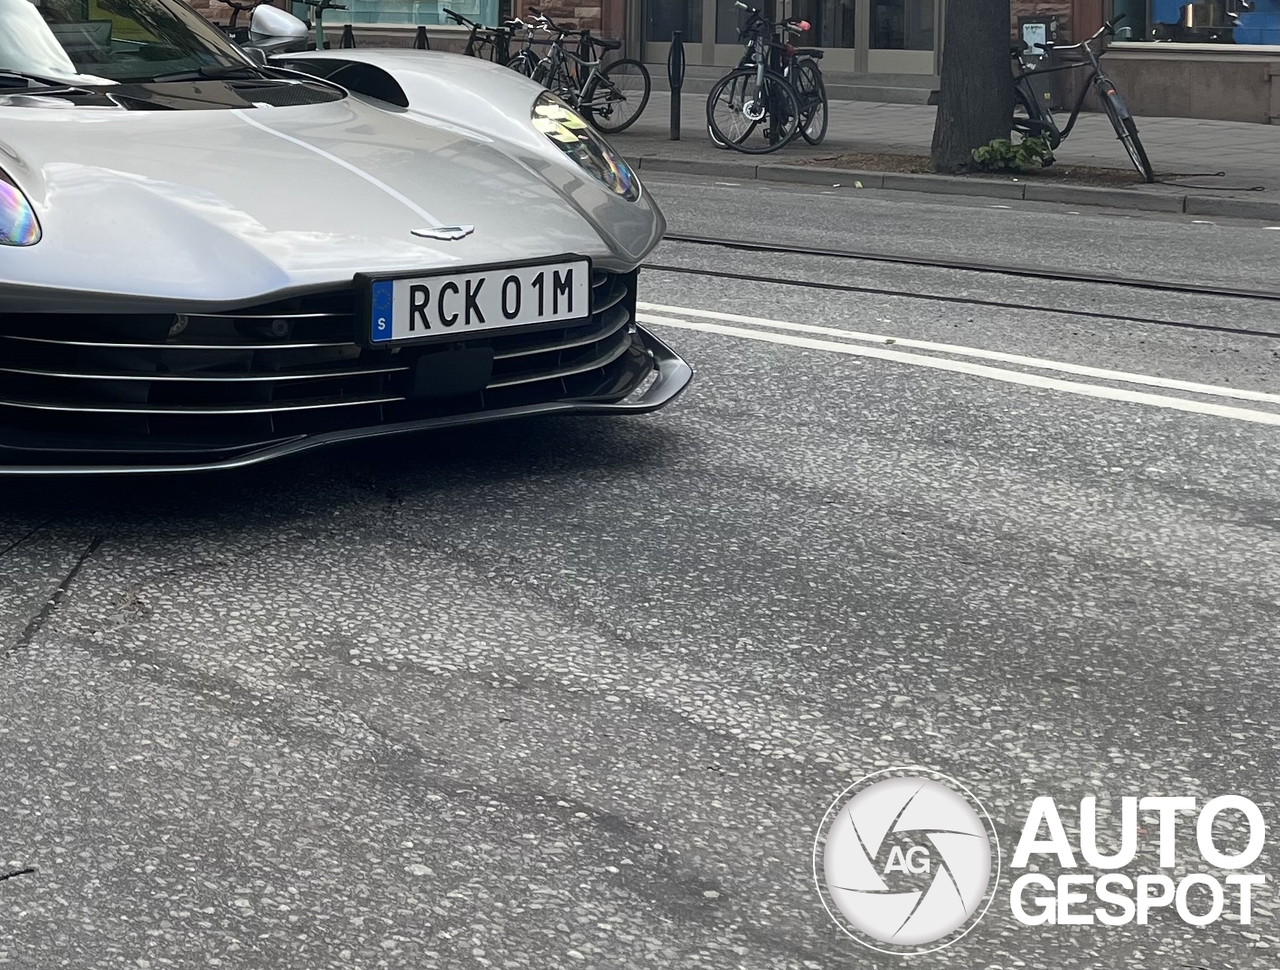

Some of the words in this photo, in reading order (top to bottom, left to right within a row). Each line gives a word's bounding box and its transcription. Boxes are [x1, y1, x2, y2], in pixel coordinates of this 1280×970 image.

[377, 316, 387, 332] S
[408, 277, 486, 332] RCK
[501, 267, 574, 320] 01M
